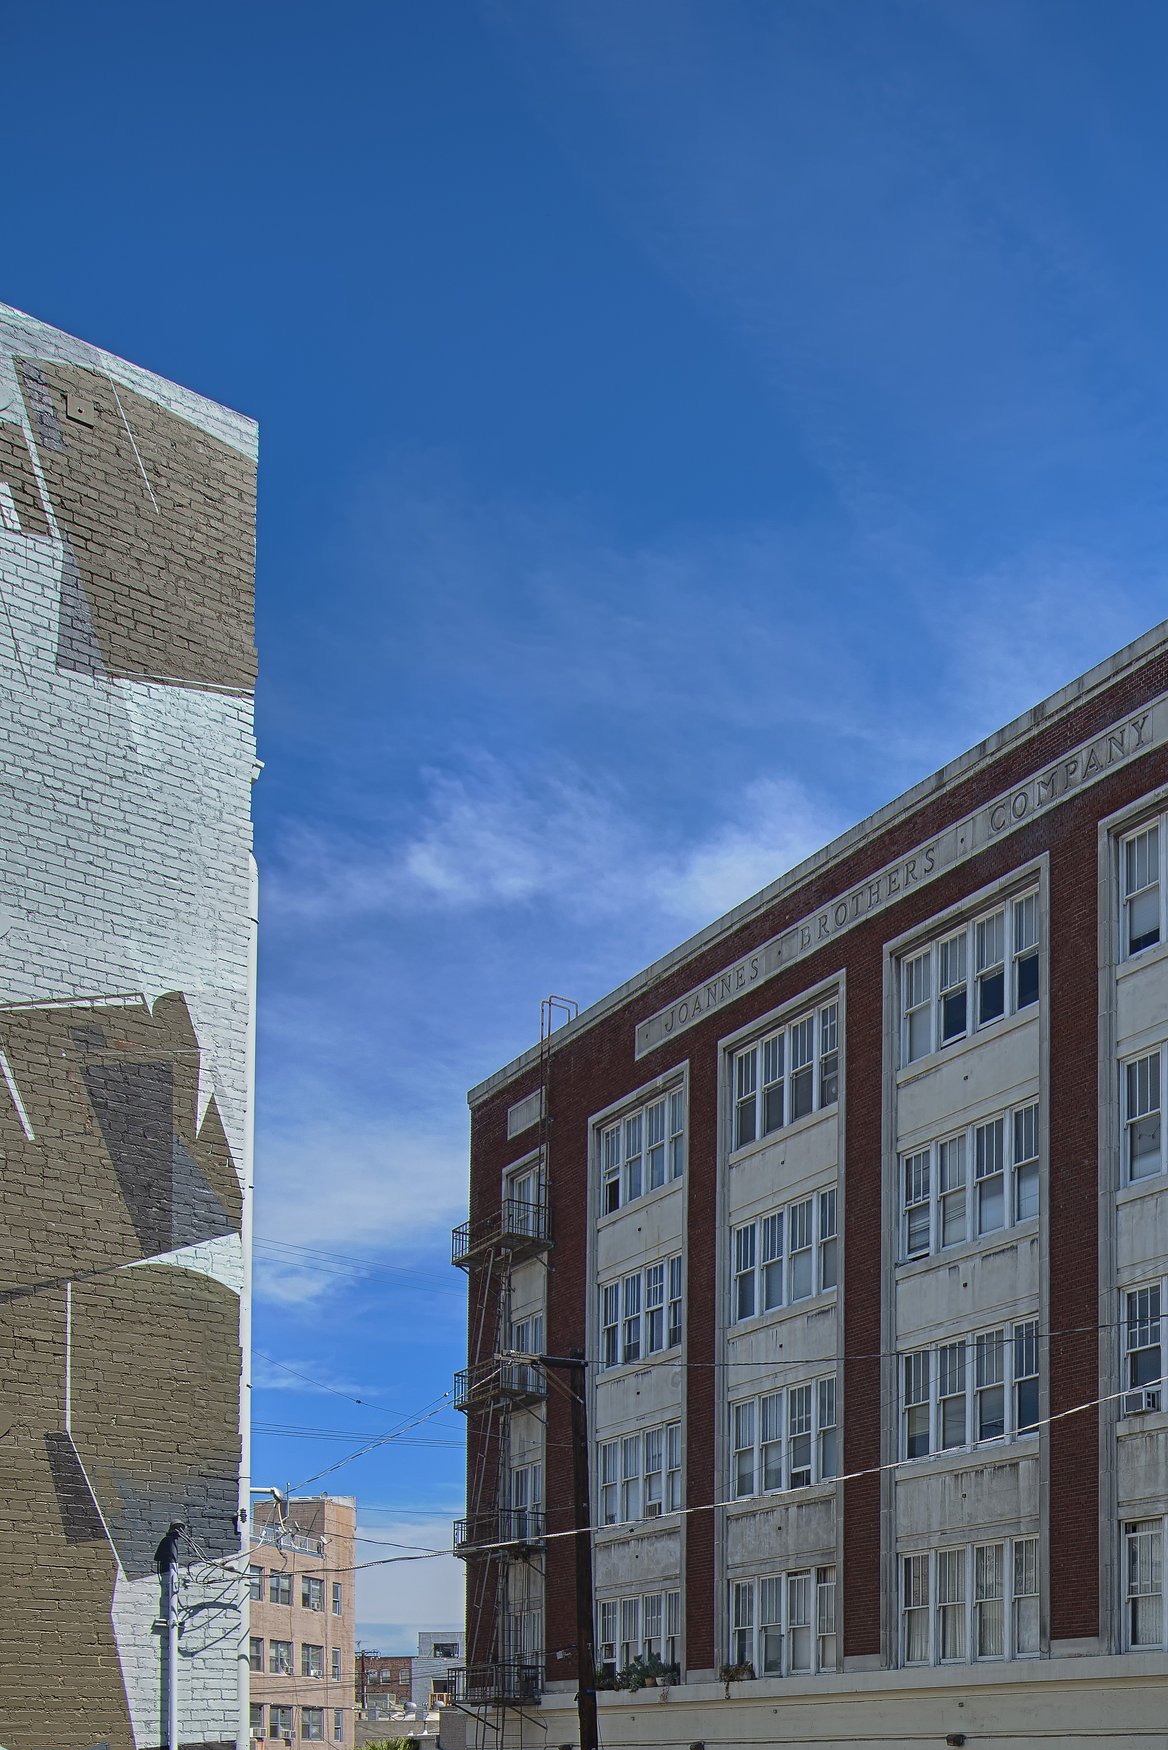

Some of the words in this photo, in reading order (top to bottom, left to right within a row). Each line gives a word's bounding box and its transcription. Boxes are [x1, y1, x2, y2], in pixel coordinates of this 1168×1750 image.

[664, 957, 760, 1034] JOANNES
[799, 846, 937, 952] BROTHERS
[988, 714, 1151, 834] COMPANY
